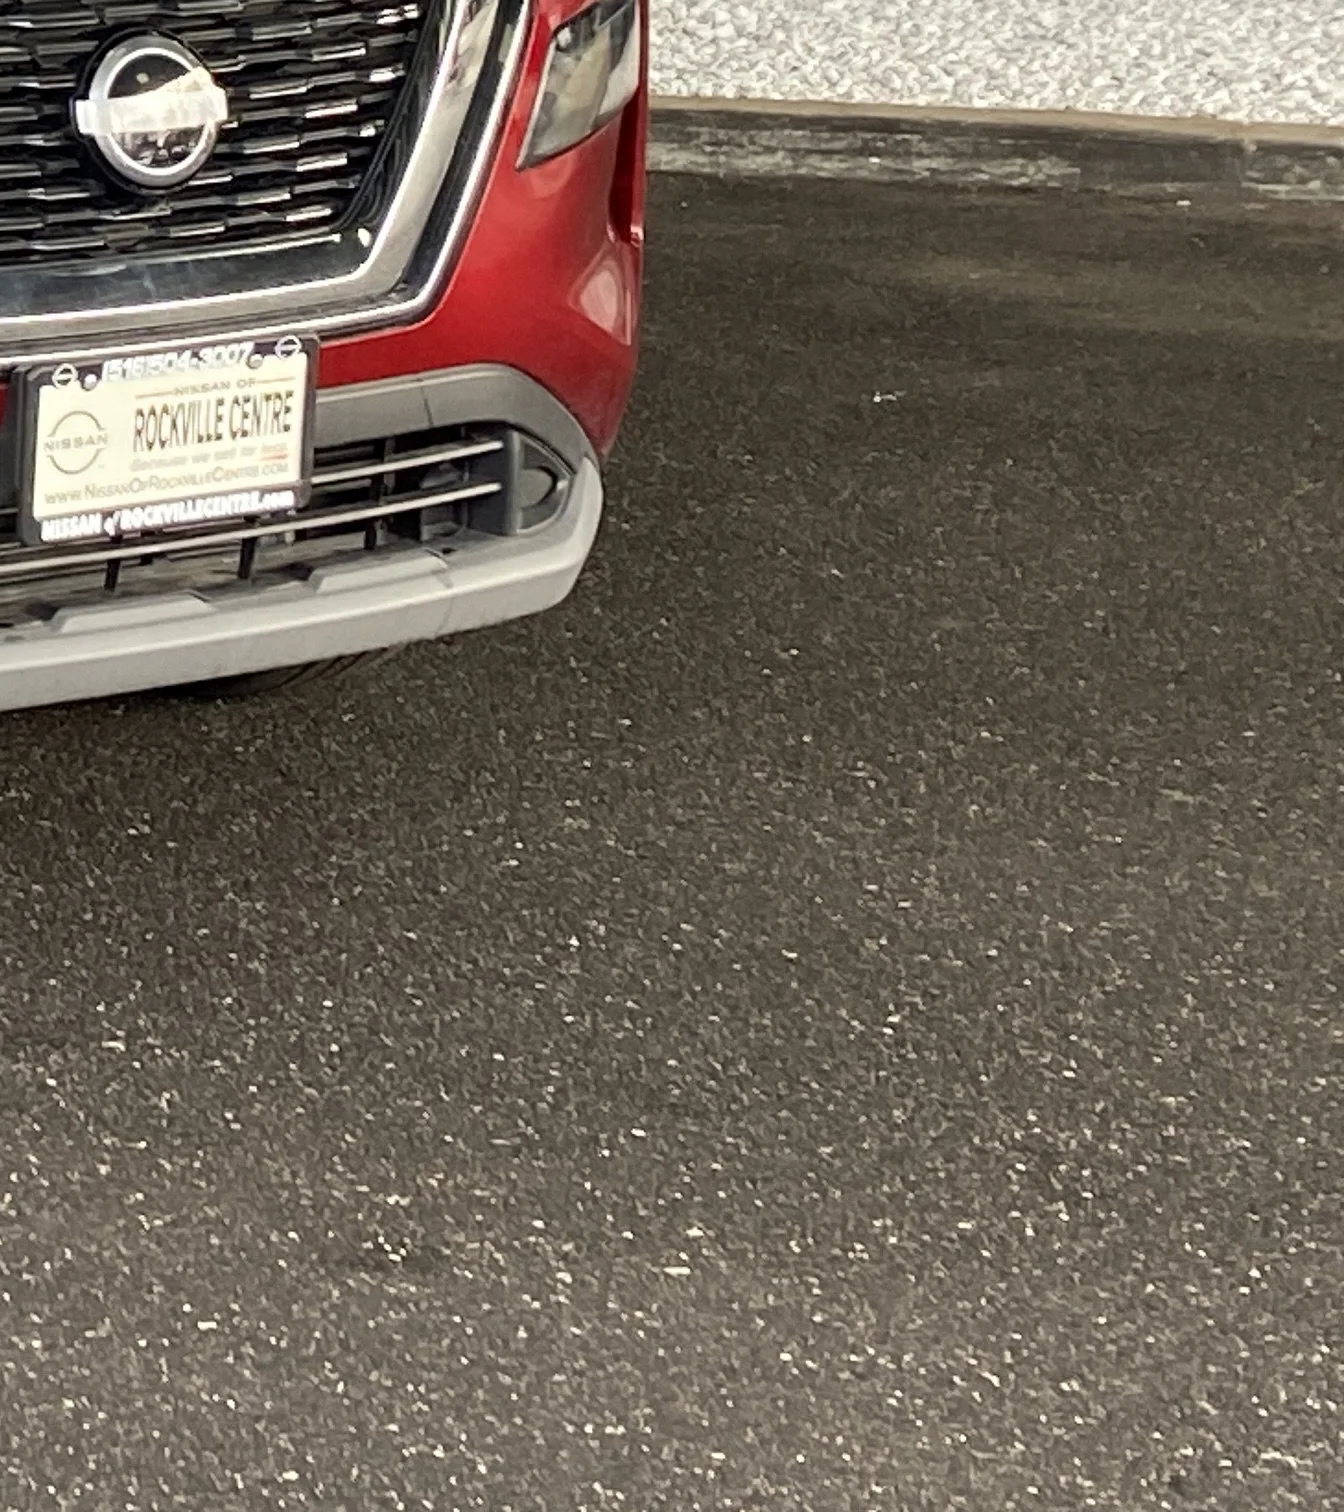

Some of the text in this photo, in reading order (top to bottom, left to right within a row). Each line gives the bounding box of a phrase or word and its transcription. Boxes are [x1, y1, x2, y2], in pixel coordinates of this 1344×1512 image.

[44, 432, 109, 452] NISSAN
[132, 389, 294, 453] ROCKVILLE CENTRE
